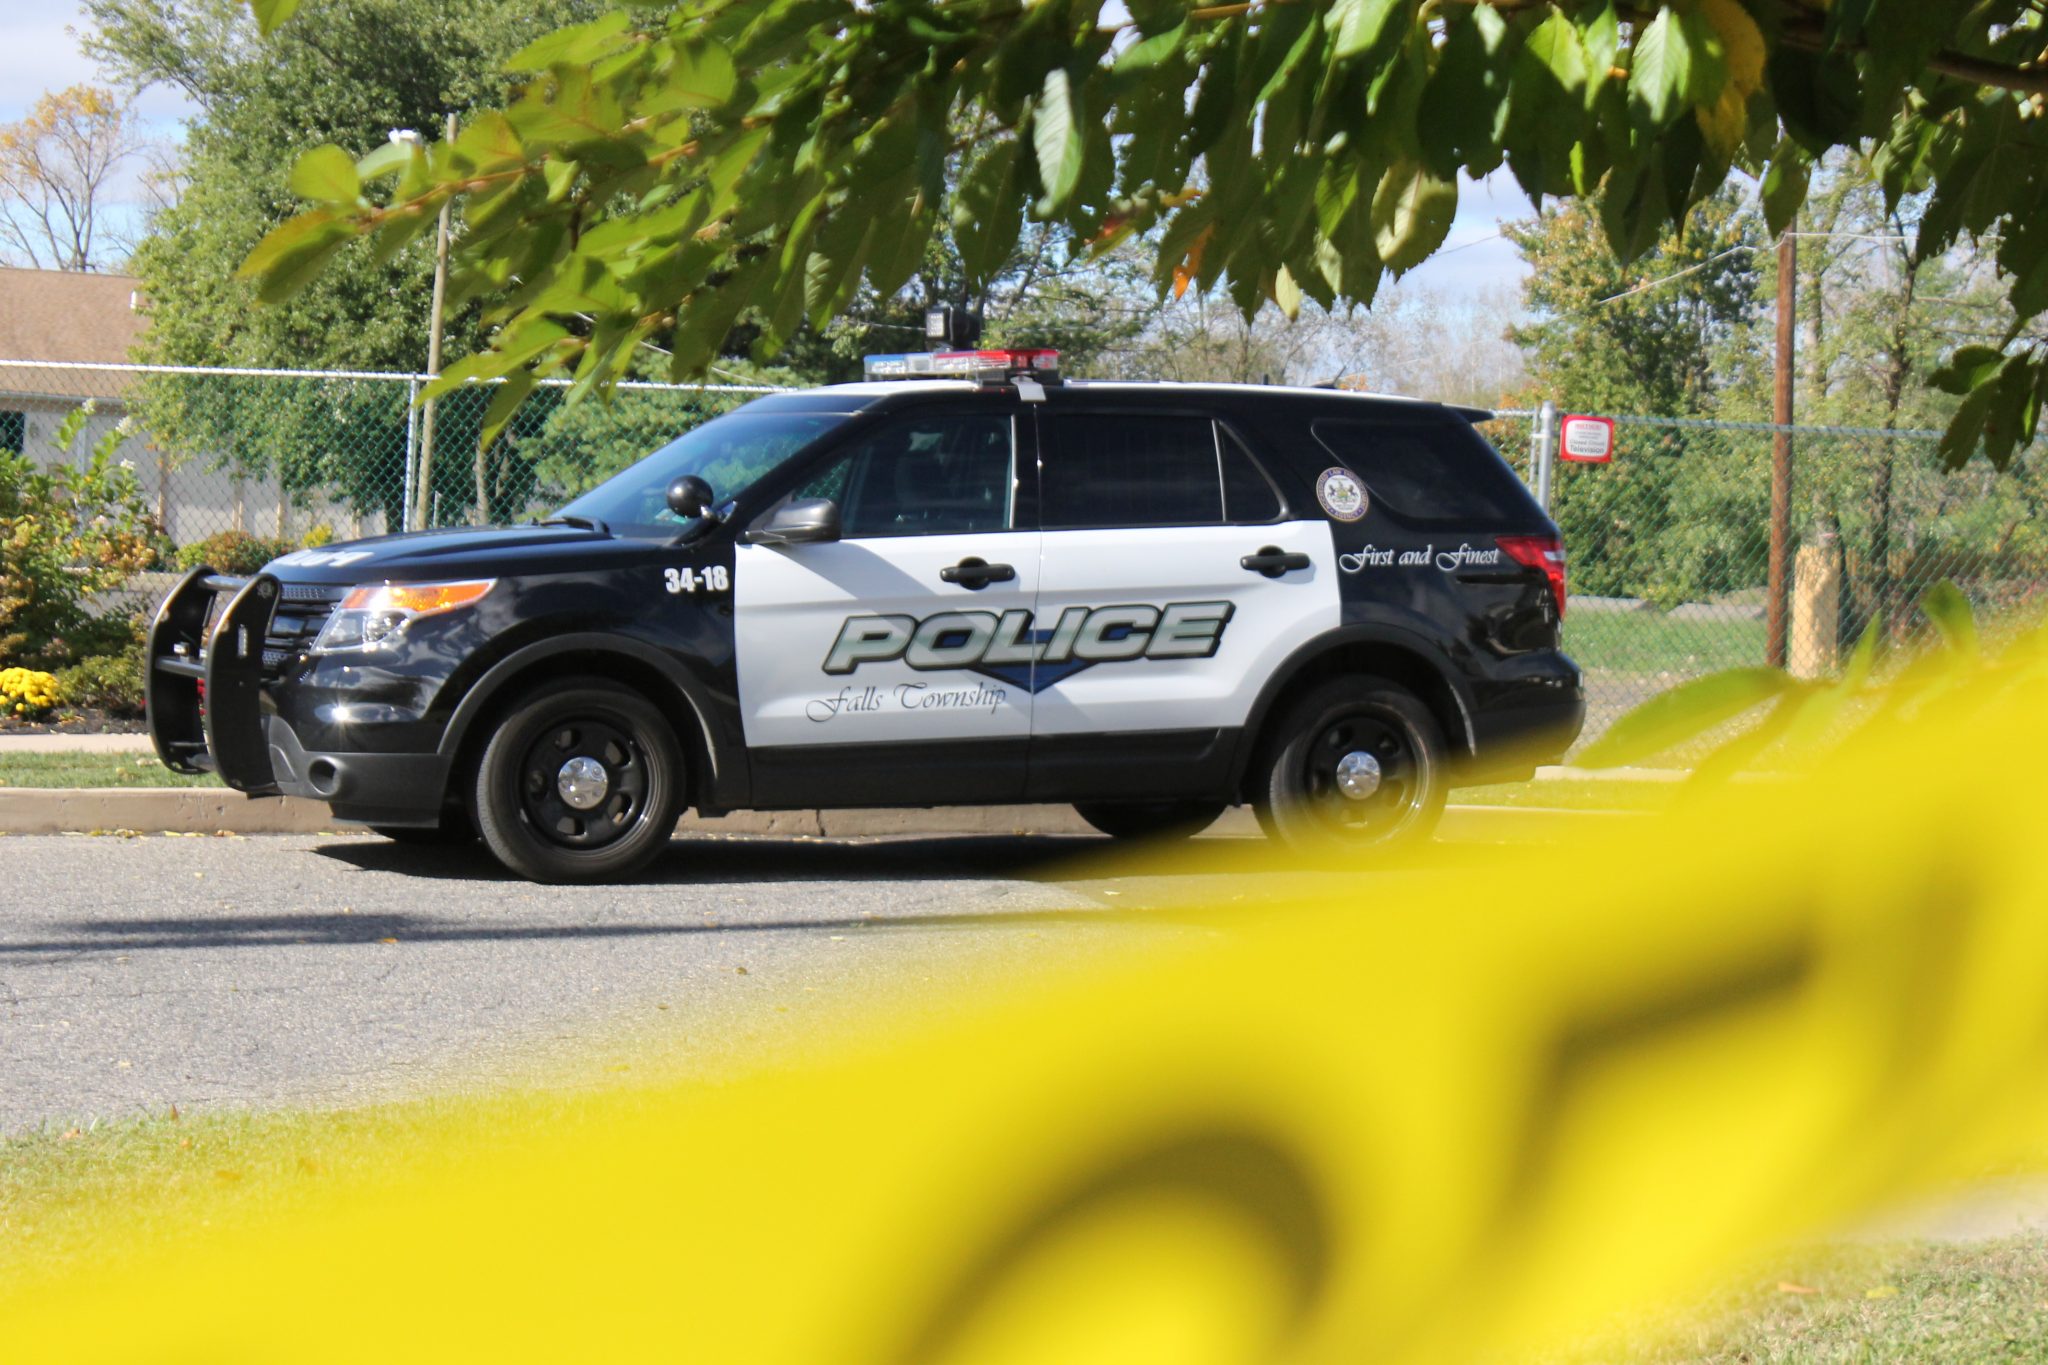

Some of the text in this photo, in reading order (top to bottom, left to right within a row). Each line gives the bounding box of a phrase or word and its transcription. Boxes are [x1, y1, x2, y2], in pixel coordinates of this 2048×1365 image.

[1570, 445, 1604, 454] Television
[1339, 543, 1499, 573] First and Finest
[664, 565, 730, 594] 34-18
[822, 600, 1236, 676] POLICE
[805, 681, 1006, 722] Falls Township
